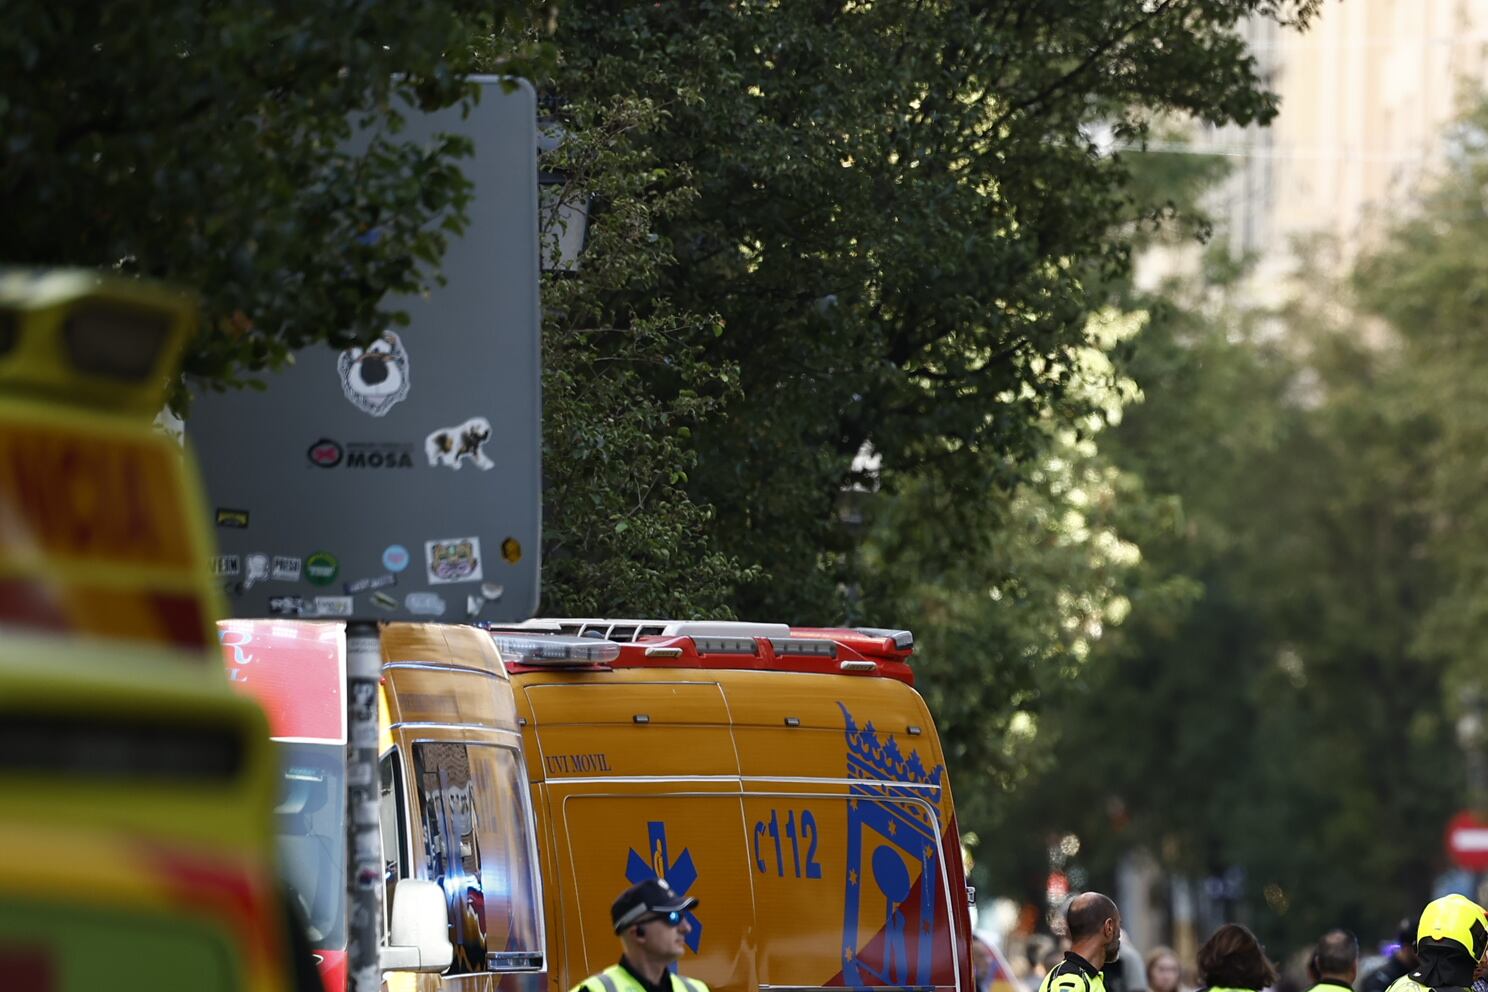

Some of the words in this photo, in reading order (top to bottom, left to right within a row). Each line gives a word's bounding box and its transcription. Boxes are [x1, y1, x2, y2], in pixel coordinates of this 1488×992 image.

[346, 451, 414, 469] MOSA
[545, 755, 569, 774] UVI
[570, 753, 612, 773] MOVIL
